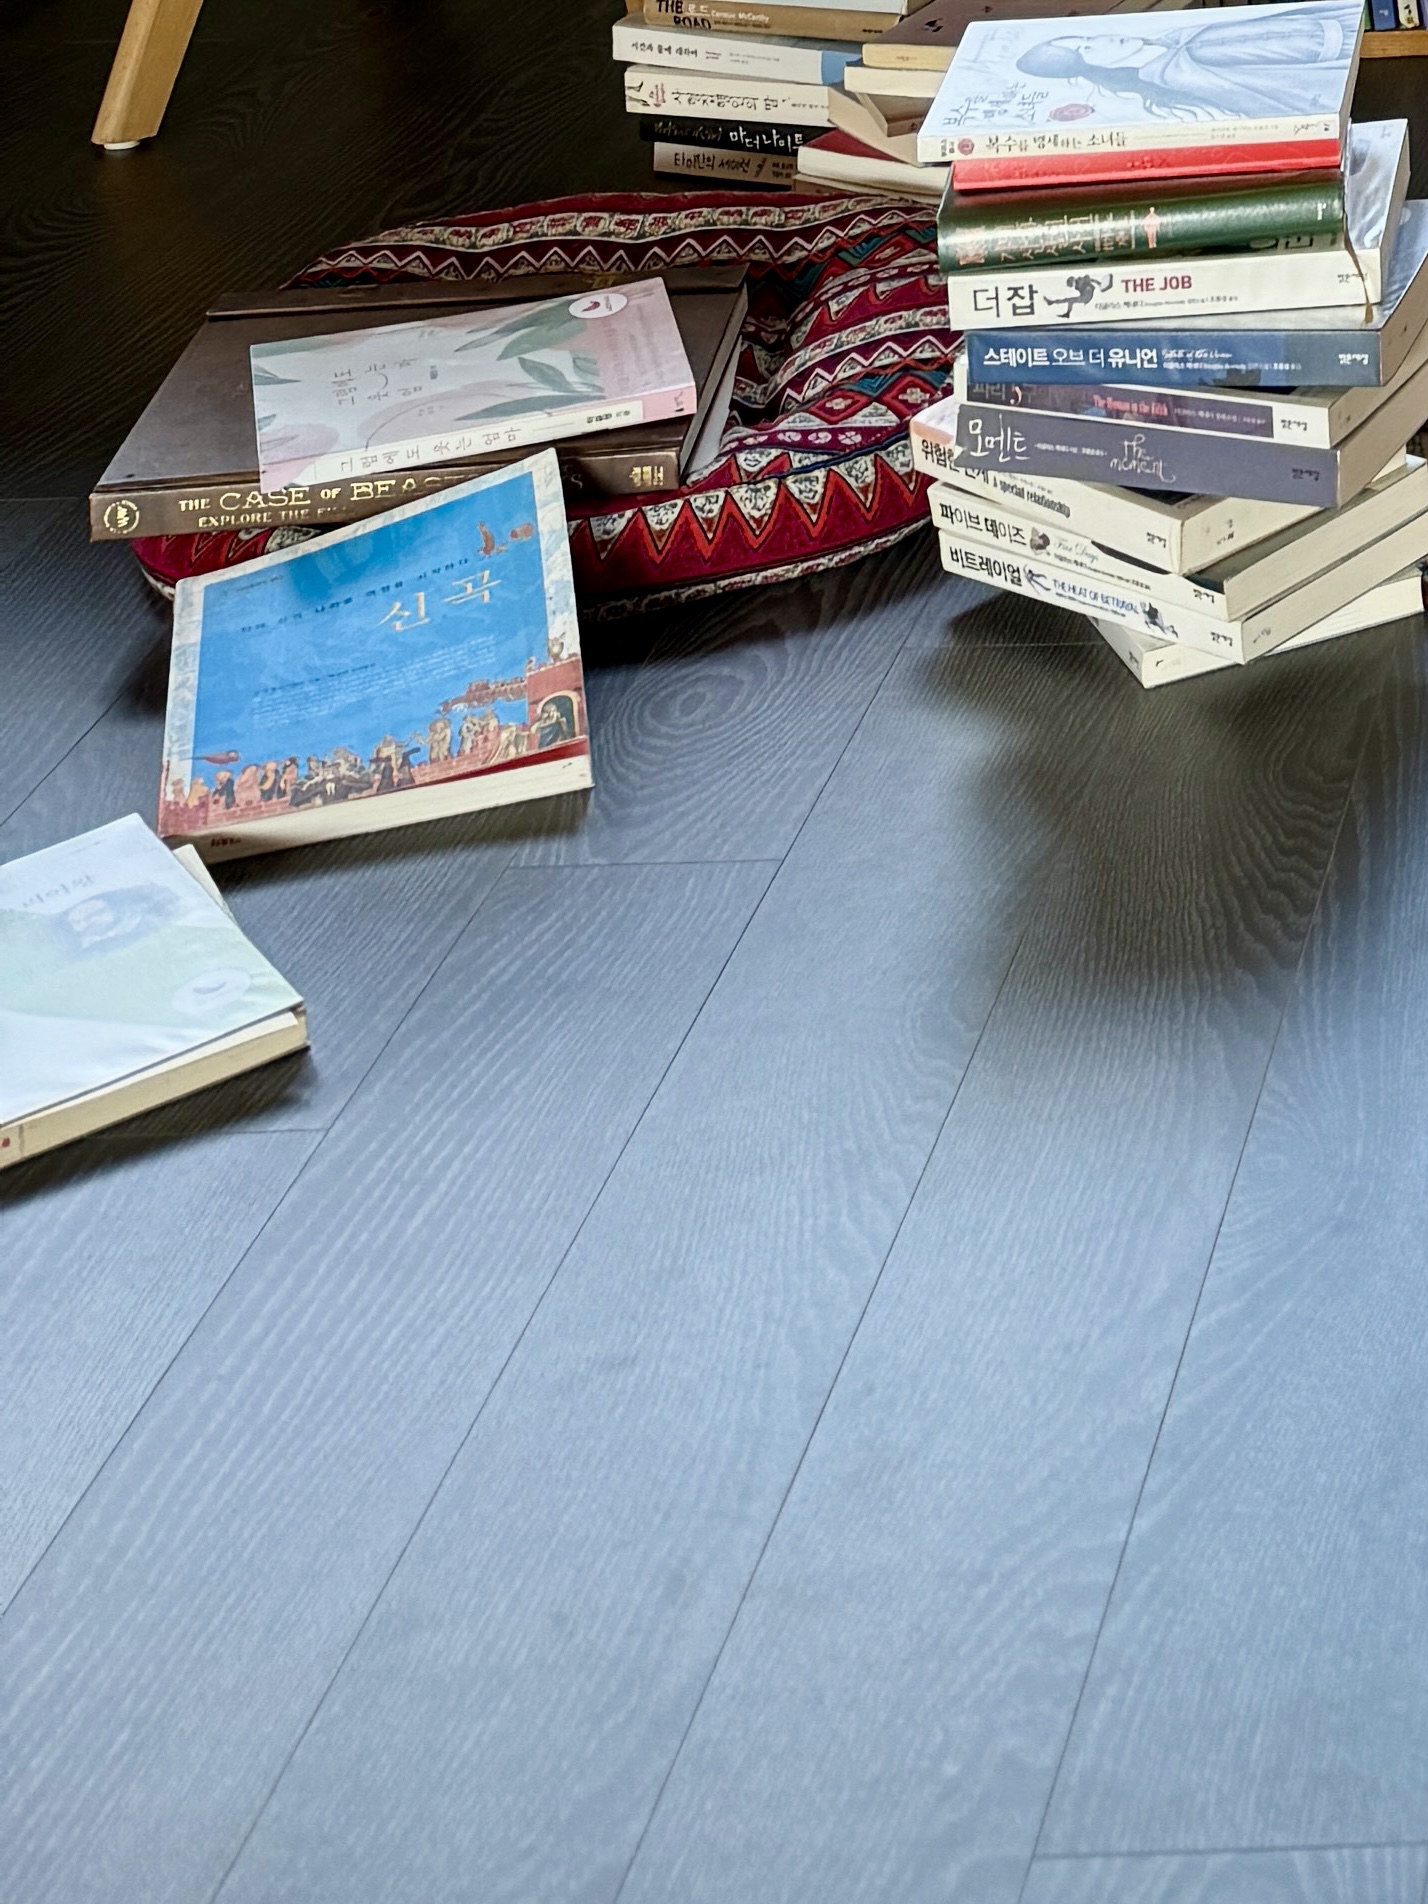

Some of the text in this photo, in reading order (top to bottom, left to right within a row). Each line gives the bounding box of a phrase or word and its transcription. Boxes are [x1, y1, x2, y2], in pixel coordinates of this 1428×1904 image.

[656, 0, 683, 14] THE
[972, 281, 1038, 319] 더 잡
[1121, 275, 1193, 293] THE JOB
[983, 347, 1158, 369] 스테이트 오브 더 유니언
[968, 413, 1032, 464] 모멘트
[178, 497, 212, 513] THE
[218, 487, 312, 511] CASE
[198, 508, 310, 530] EXPLORE THE
[939, 503, 1028, 546] 파이브 데이즈
[949, 546, 1023, 586] 비트레이얼
[379, 568, 501, 632] 신곡
